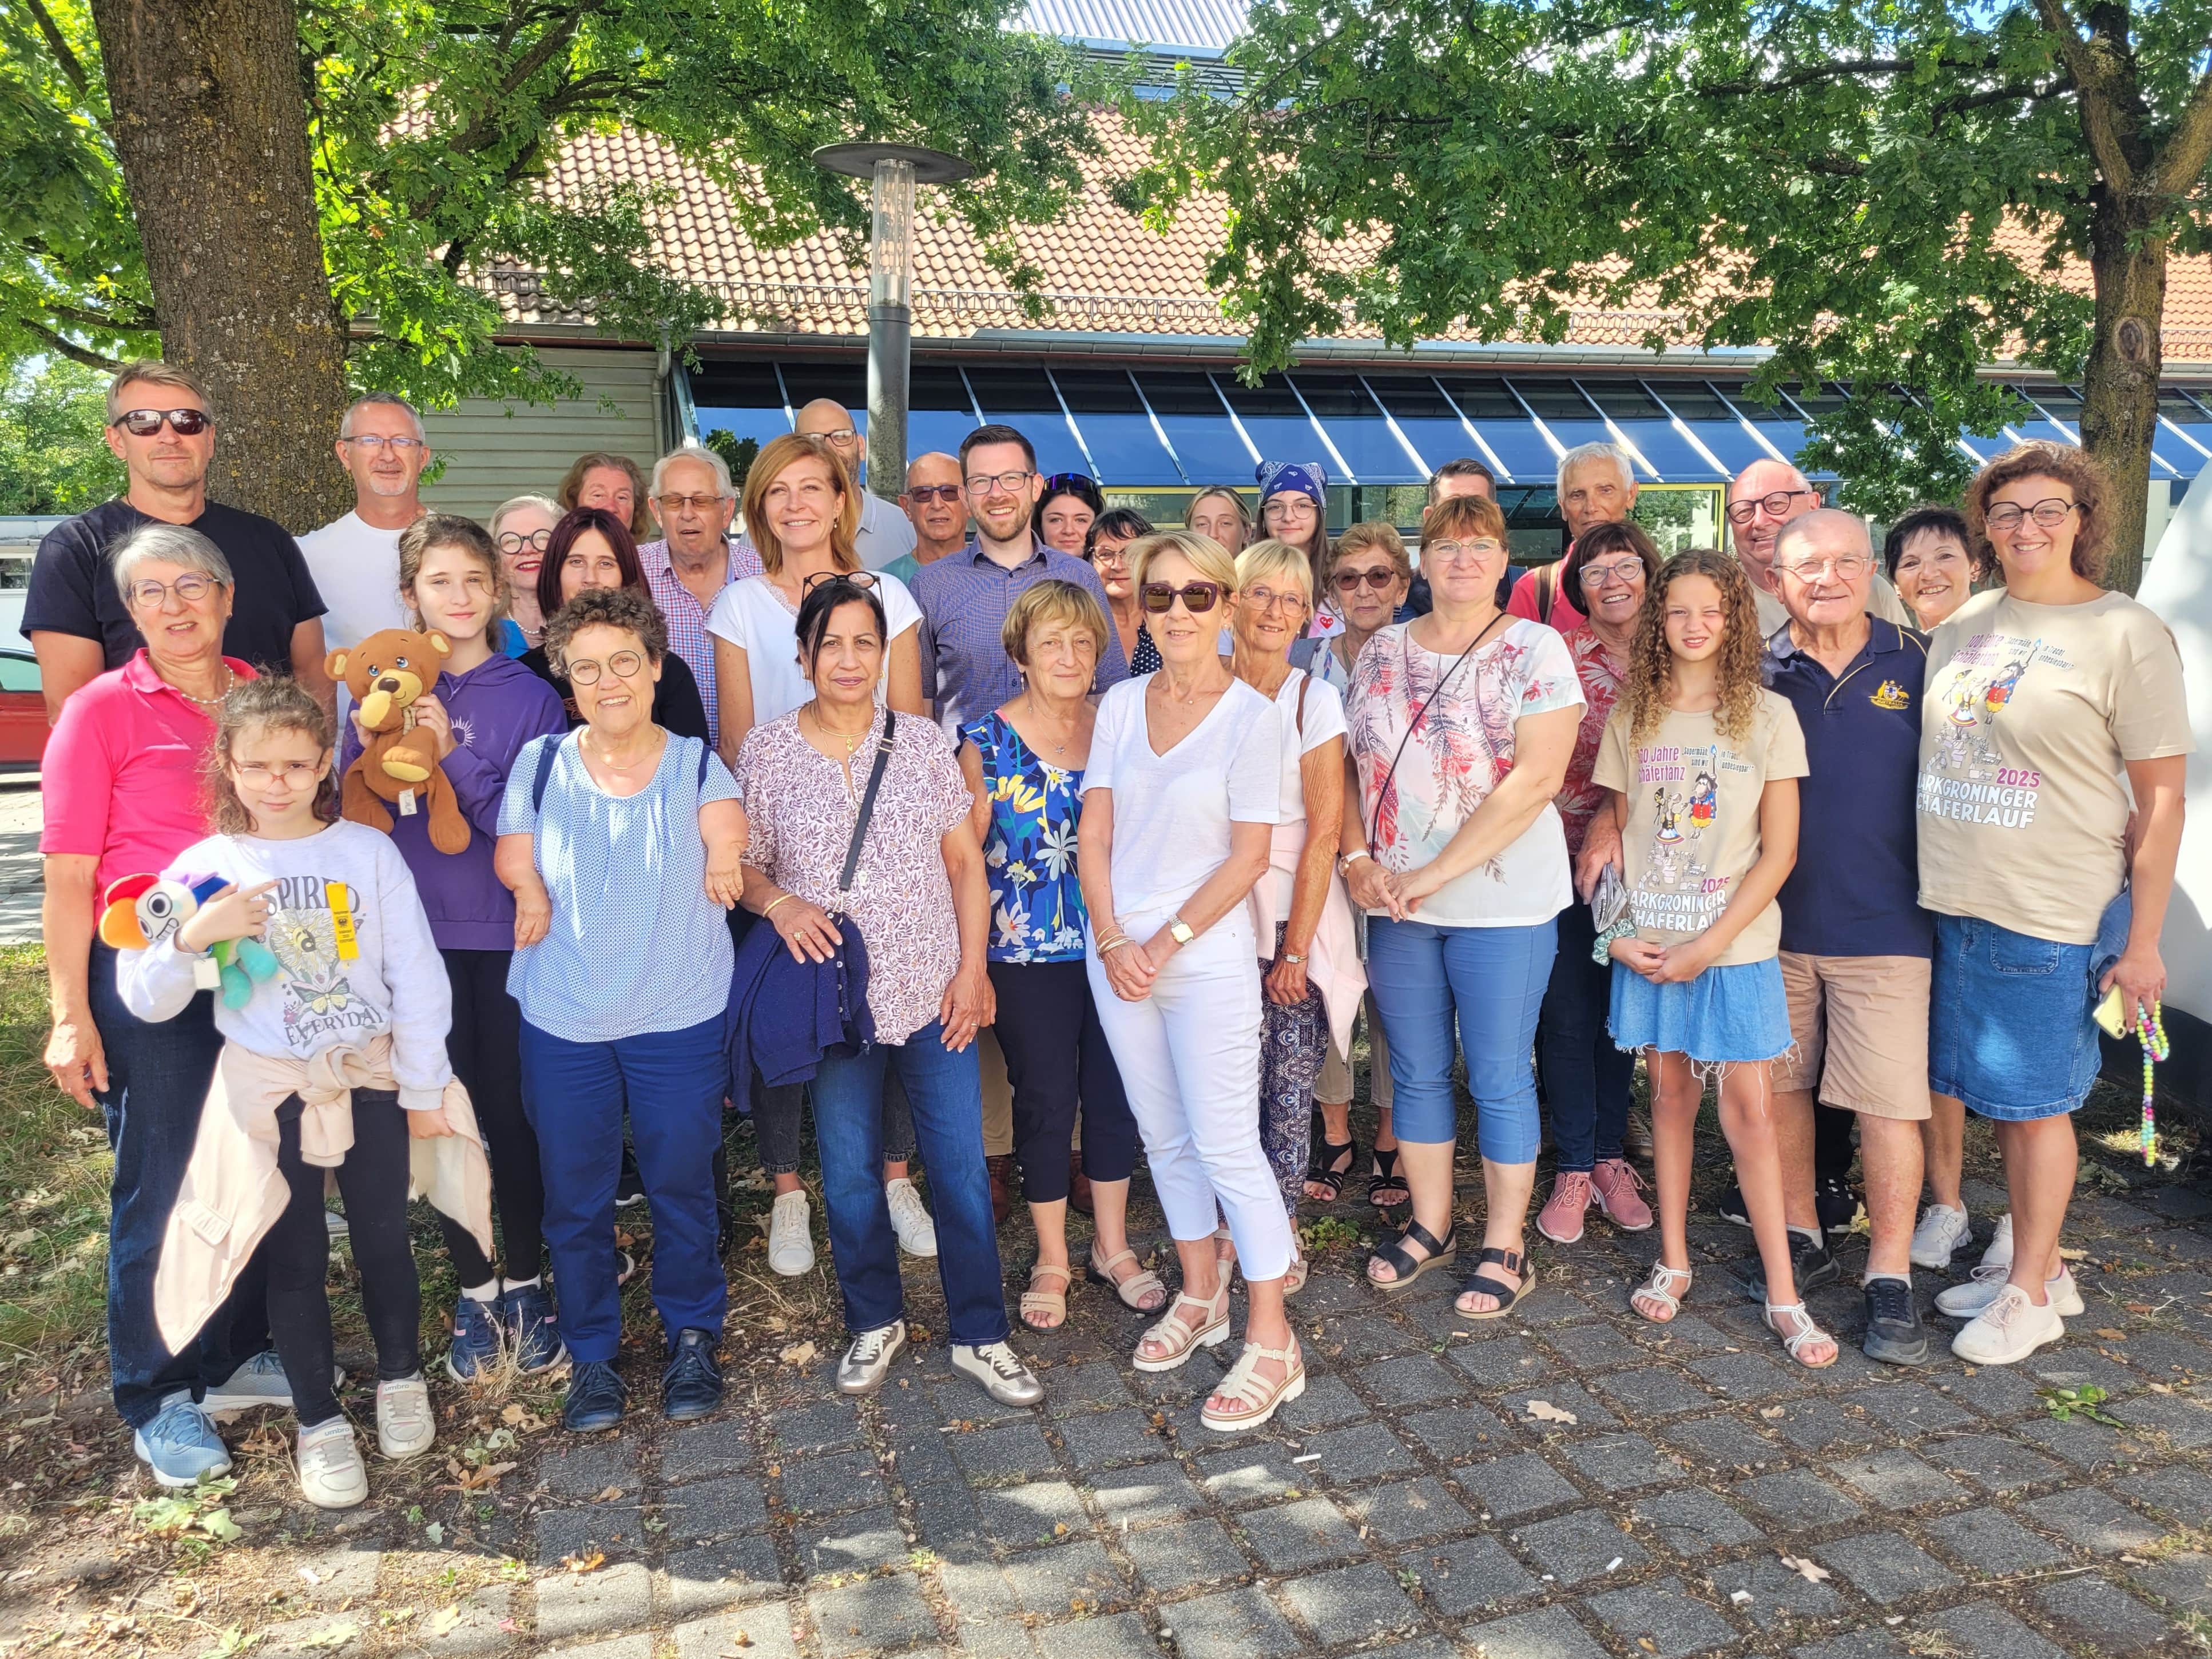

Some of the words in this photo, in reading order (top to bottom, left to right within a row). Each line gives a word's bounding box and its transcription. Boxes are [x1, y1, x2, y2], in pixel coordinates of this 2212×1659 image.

[1638, 748, 1649, 764] 00
[1651, 745, 1679, 762] Jahre
[1639, 765, 1686, 783] häfertanz
[1996, 767, 2041, 788] 2025
[1917, 793, 2035, 829] CHÄFERLAUF
[1627, 906, 1727, 932] HÄFERLAU
[284, 1006, 384, 1046] EVERYDAY
[385, 1383, 410, 1391] umbro
[324, 1427, 350, 1437] umbro
